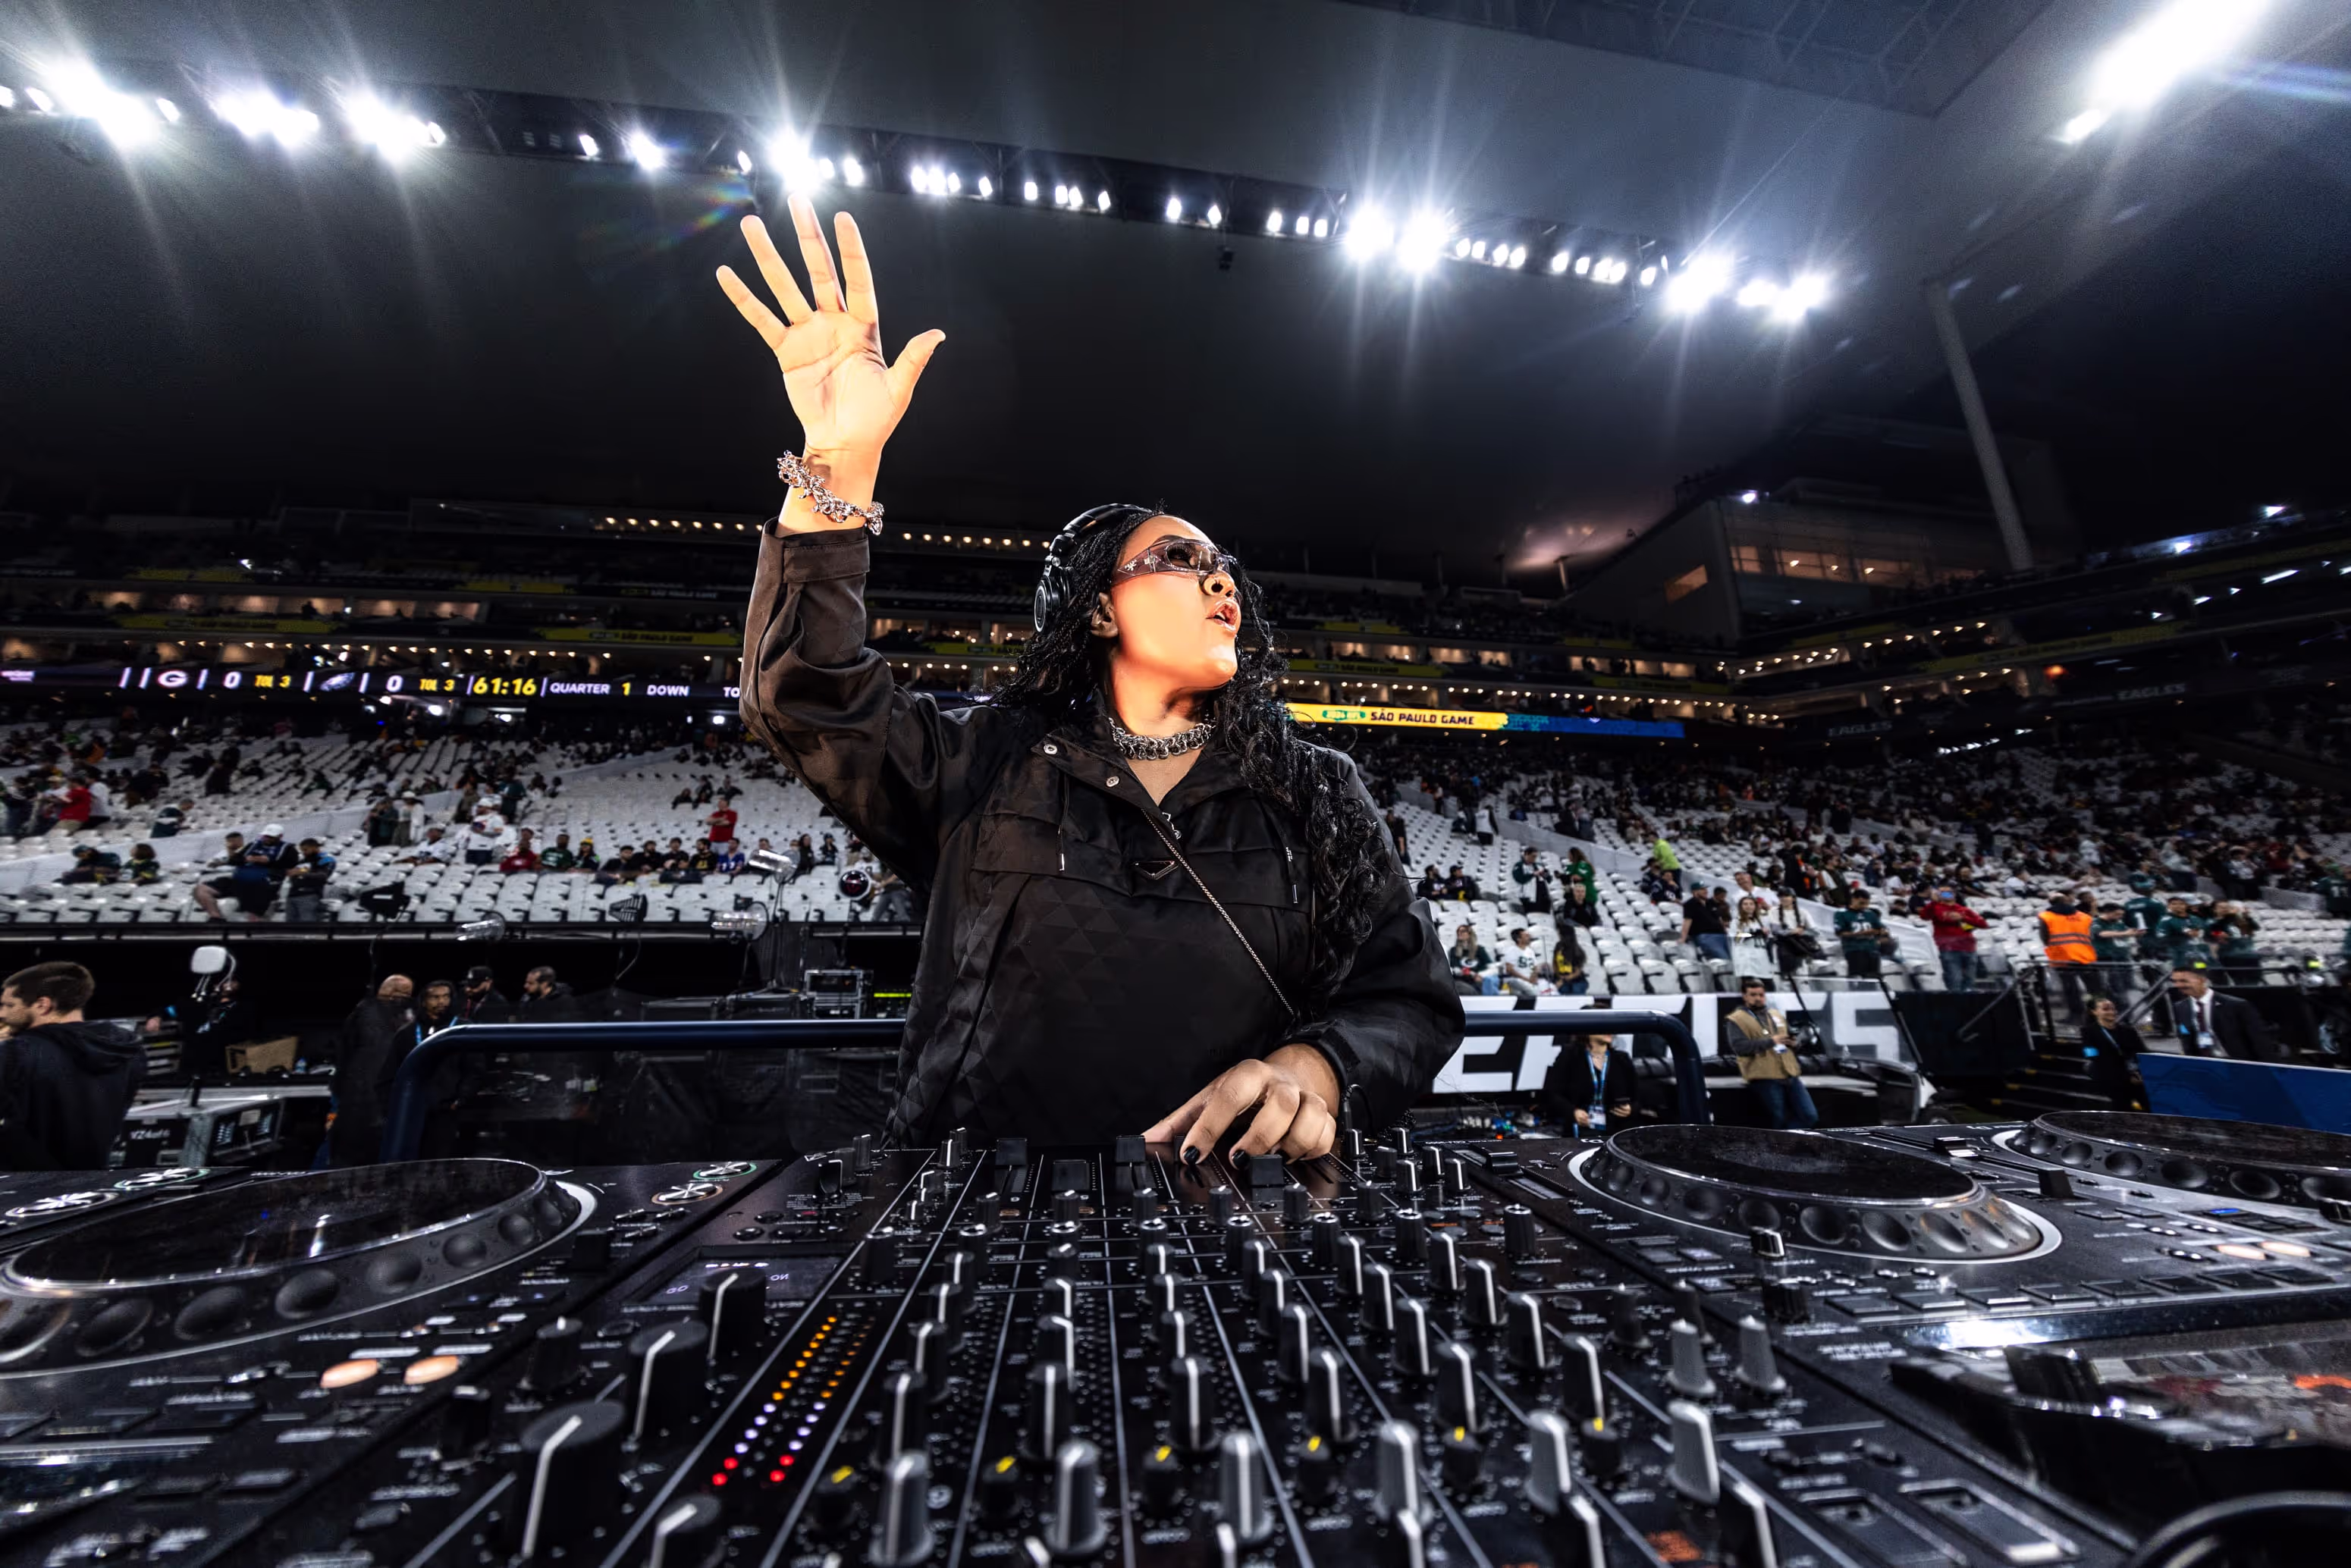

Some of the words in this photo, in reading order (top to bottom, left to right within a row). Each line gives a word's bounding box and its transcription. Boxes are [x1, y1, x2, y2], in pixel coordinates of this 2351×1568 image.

[224, 672, 241, 688] 0
[255, 676, 273, 688] TOL
[280, 675, 290, 688] 3
[386, 676, 403, 691] 0
[419, 679, 437, 691] TOL
[444, 679, 454, 691] 3
[473, 676, 536, 695] 61:16
[550, 682, 611, 694] QUARTER
[622, 682, 631, 695] 1
[647, 685, 689, 696] DOWN
[724, 686, 740, 698] TO
[1371, 708, 1394, 721] SÃO
[1398, 713, 1436, 723] PAULO
[1441, 713, 1474, 725] GAME
